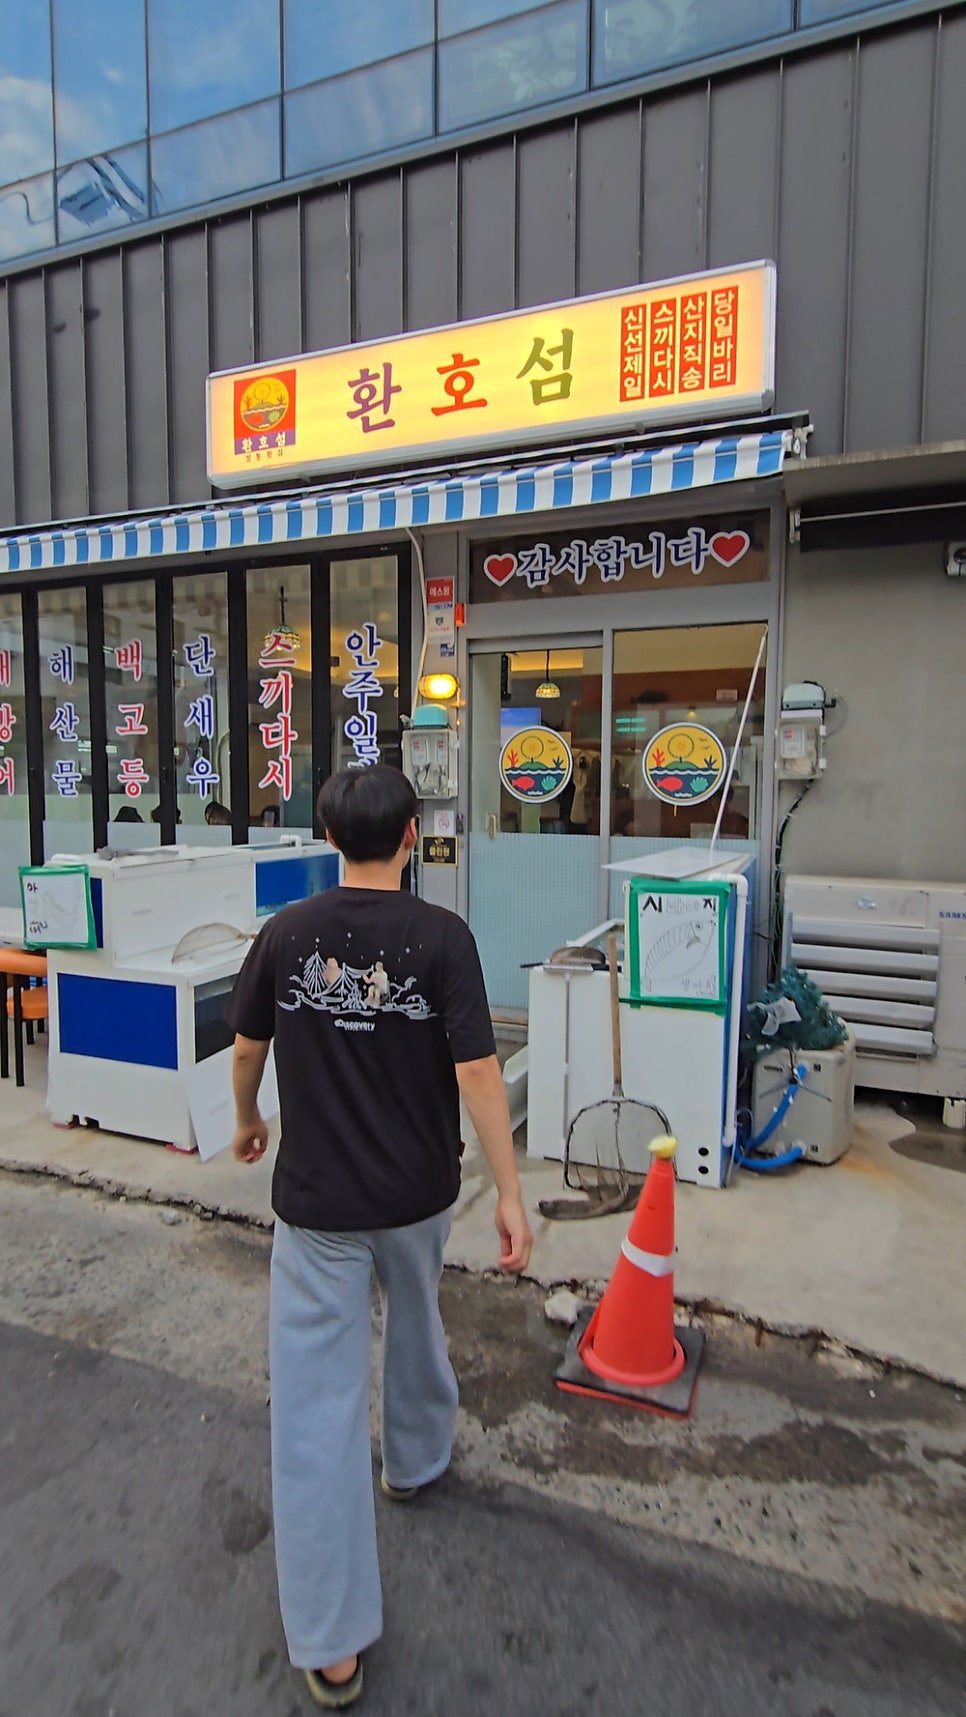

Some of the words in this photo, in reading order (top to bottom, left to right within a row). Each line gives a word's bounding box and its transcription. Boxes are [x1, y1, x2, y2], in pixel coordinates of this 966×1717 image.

[346, 328, 574, 434] 환호섬
[624, 307, 643, 399] 신선제일
[652, 303, 675, 392] 스끼다시
[681, 296, 705, 390] 산지직송
[713, 290, 735, 383] 당일바리
[242, 431, 286, 453] 환호섬
[518, 529, 710, 587] 감사합니다
[50, 645, 82, 797] 해산물
[115, 640, 149, 797] 백고등
[184, 635, 219, 799] 단새우
[259, 633, 298, 800] 스끼다시
[344, 624, 383, 768] 안주일
